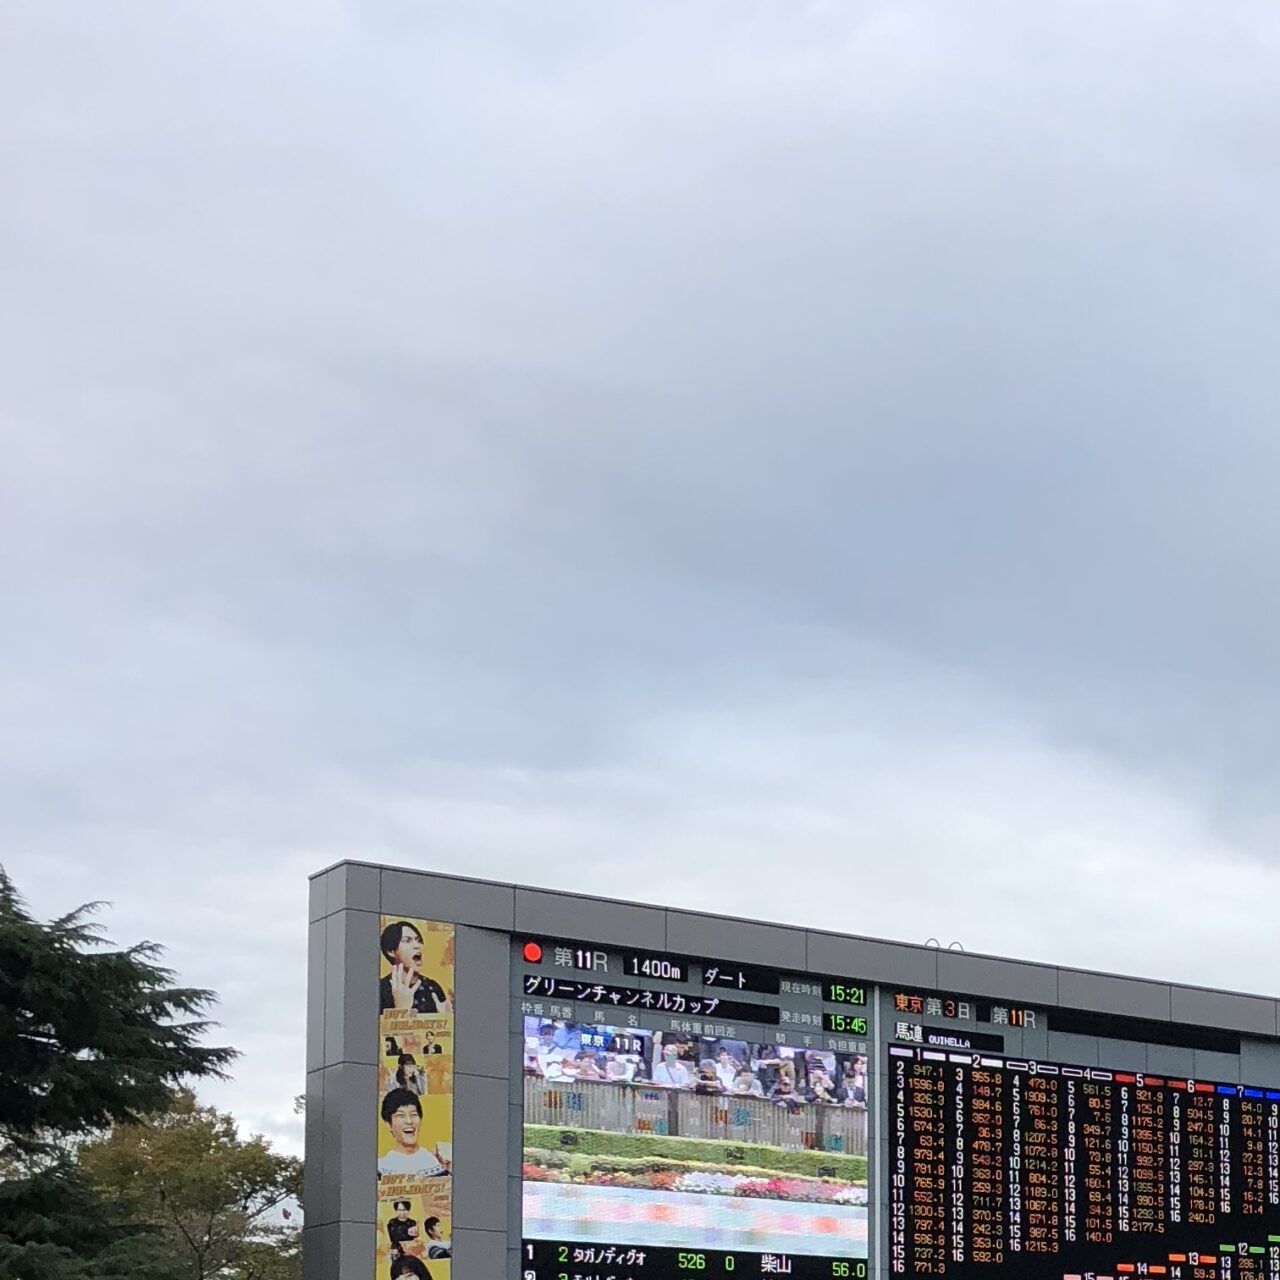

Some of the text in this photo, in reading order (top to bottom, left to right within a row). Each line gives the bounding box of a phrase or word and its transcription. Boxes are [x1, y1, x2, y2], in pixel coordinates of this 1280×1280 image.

[554, 947, 746, 988] 第11R 1400m ダート
[526, 976, 719, 1014] グリーンチャンネルカップ
[781, 981, 821, 996] 現在時刻
[830, 984, 864, 1004] 15:21
[781, 1011, 821, 1026] 発走時刻
[830, 1015, 866, 1033] 15:45
[928, 1034, 970, 1048] QUINELLA
[527, 1245, 865, 1277] 1 2 タガノディグオ 526 0 柴山 56.0
